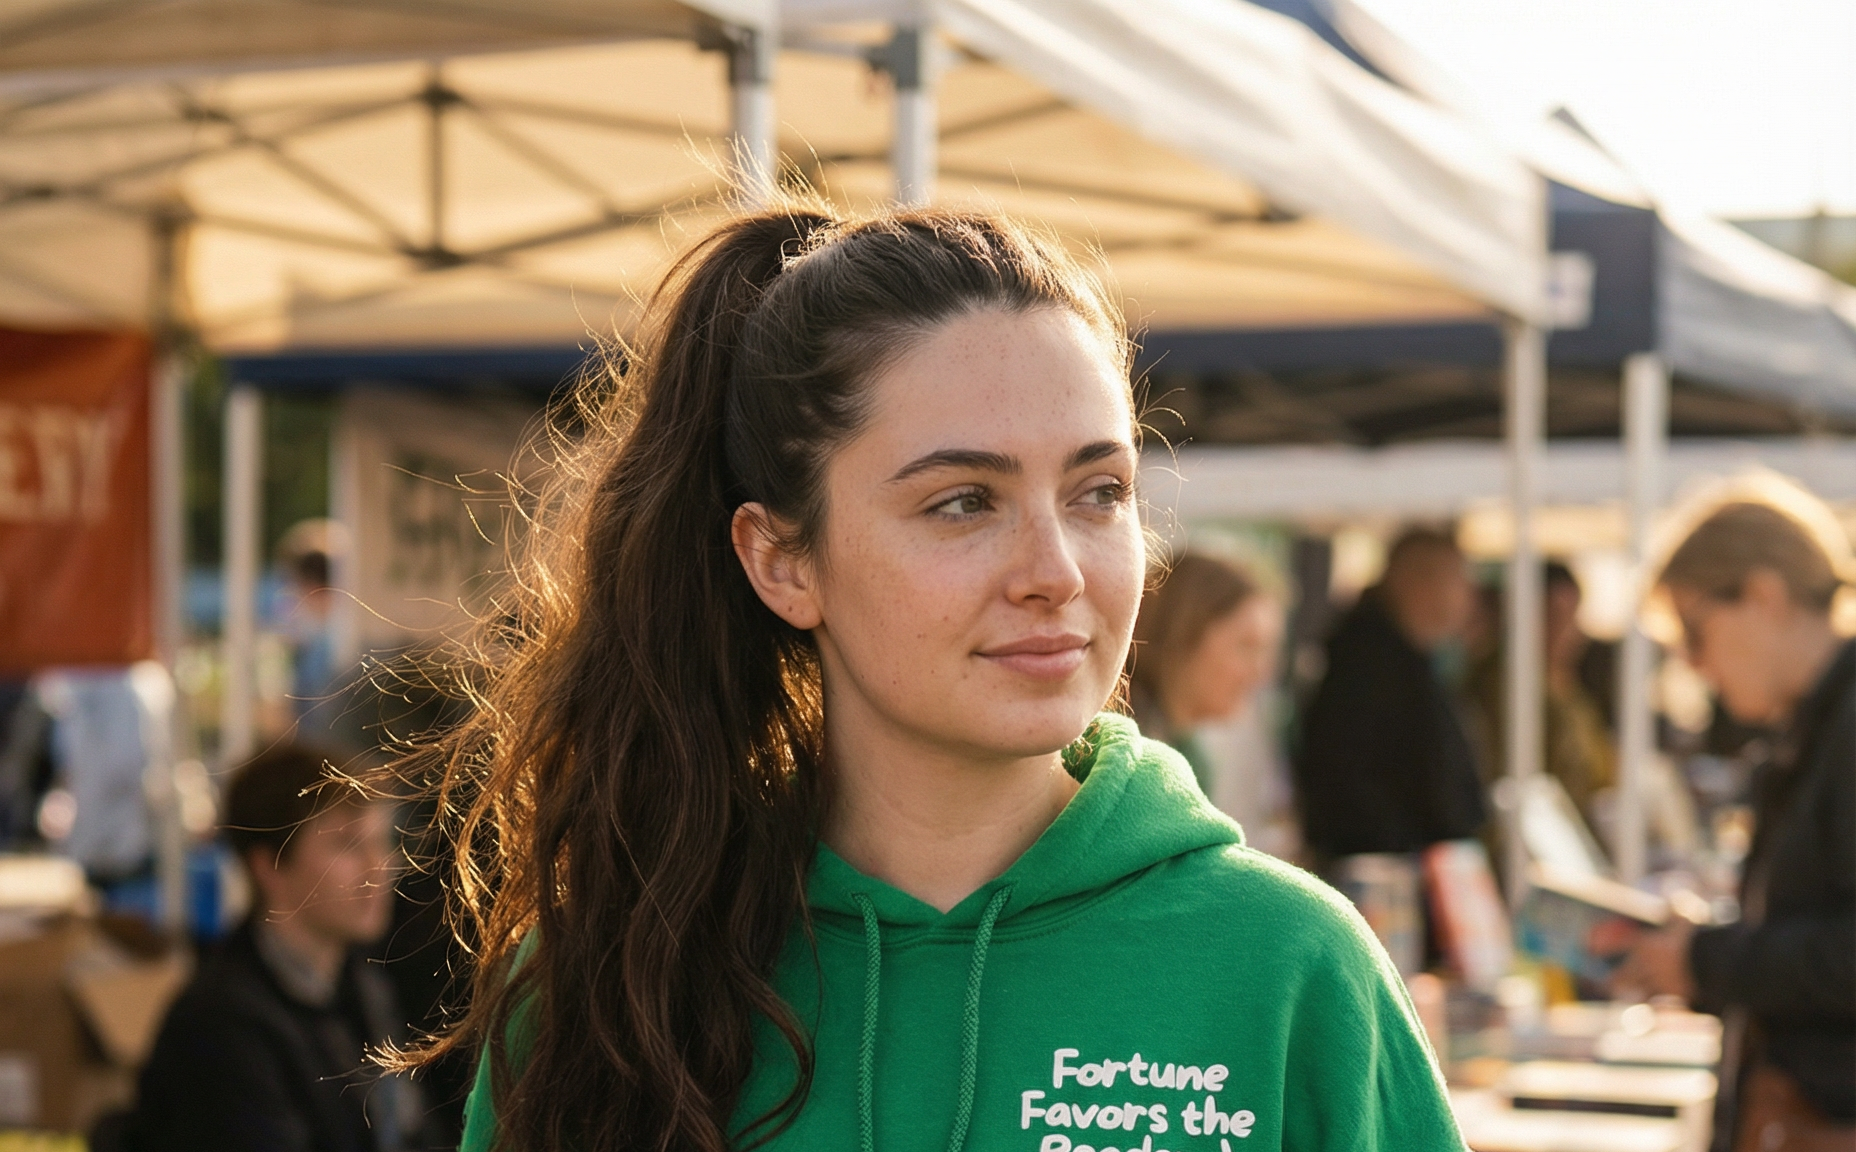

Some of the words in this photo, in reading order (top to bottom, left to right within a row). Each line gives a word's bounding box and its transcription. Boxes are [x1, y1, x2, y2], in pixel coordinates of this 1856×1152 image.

[1053, 1048, 1229, 1092] Fortune
[1021, 1090, 1169, 1134] Favors
[1181, 1095, 1255, 1138] the
